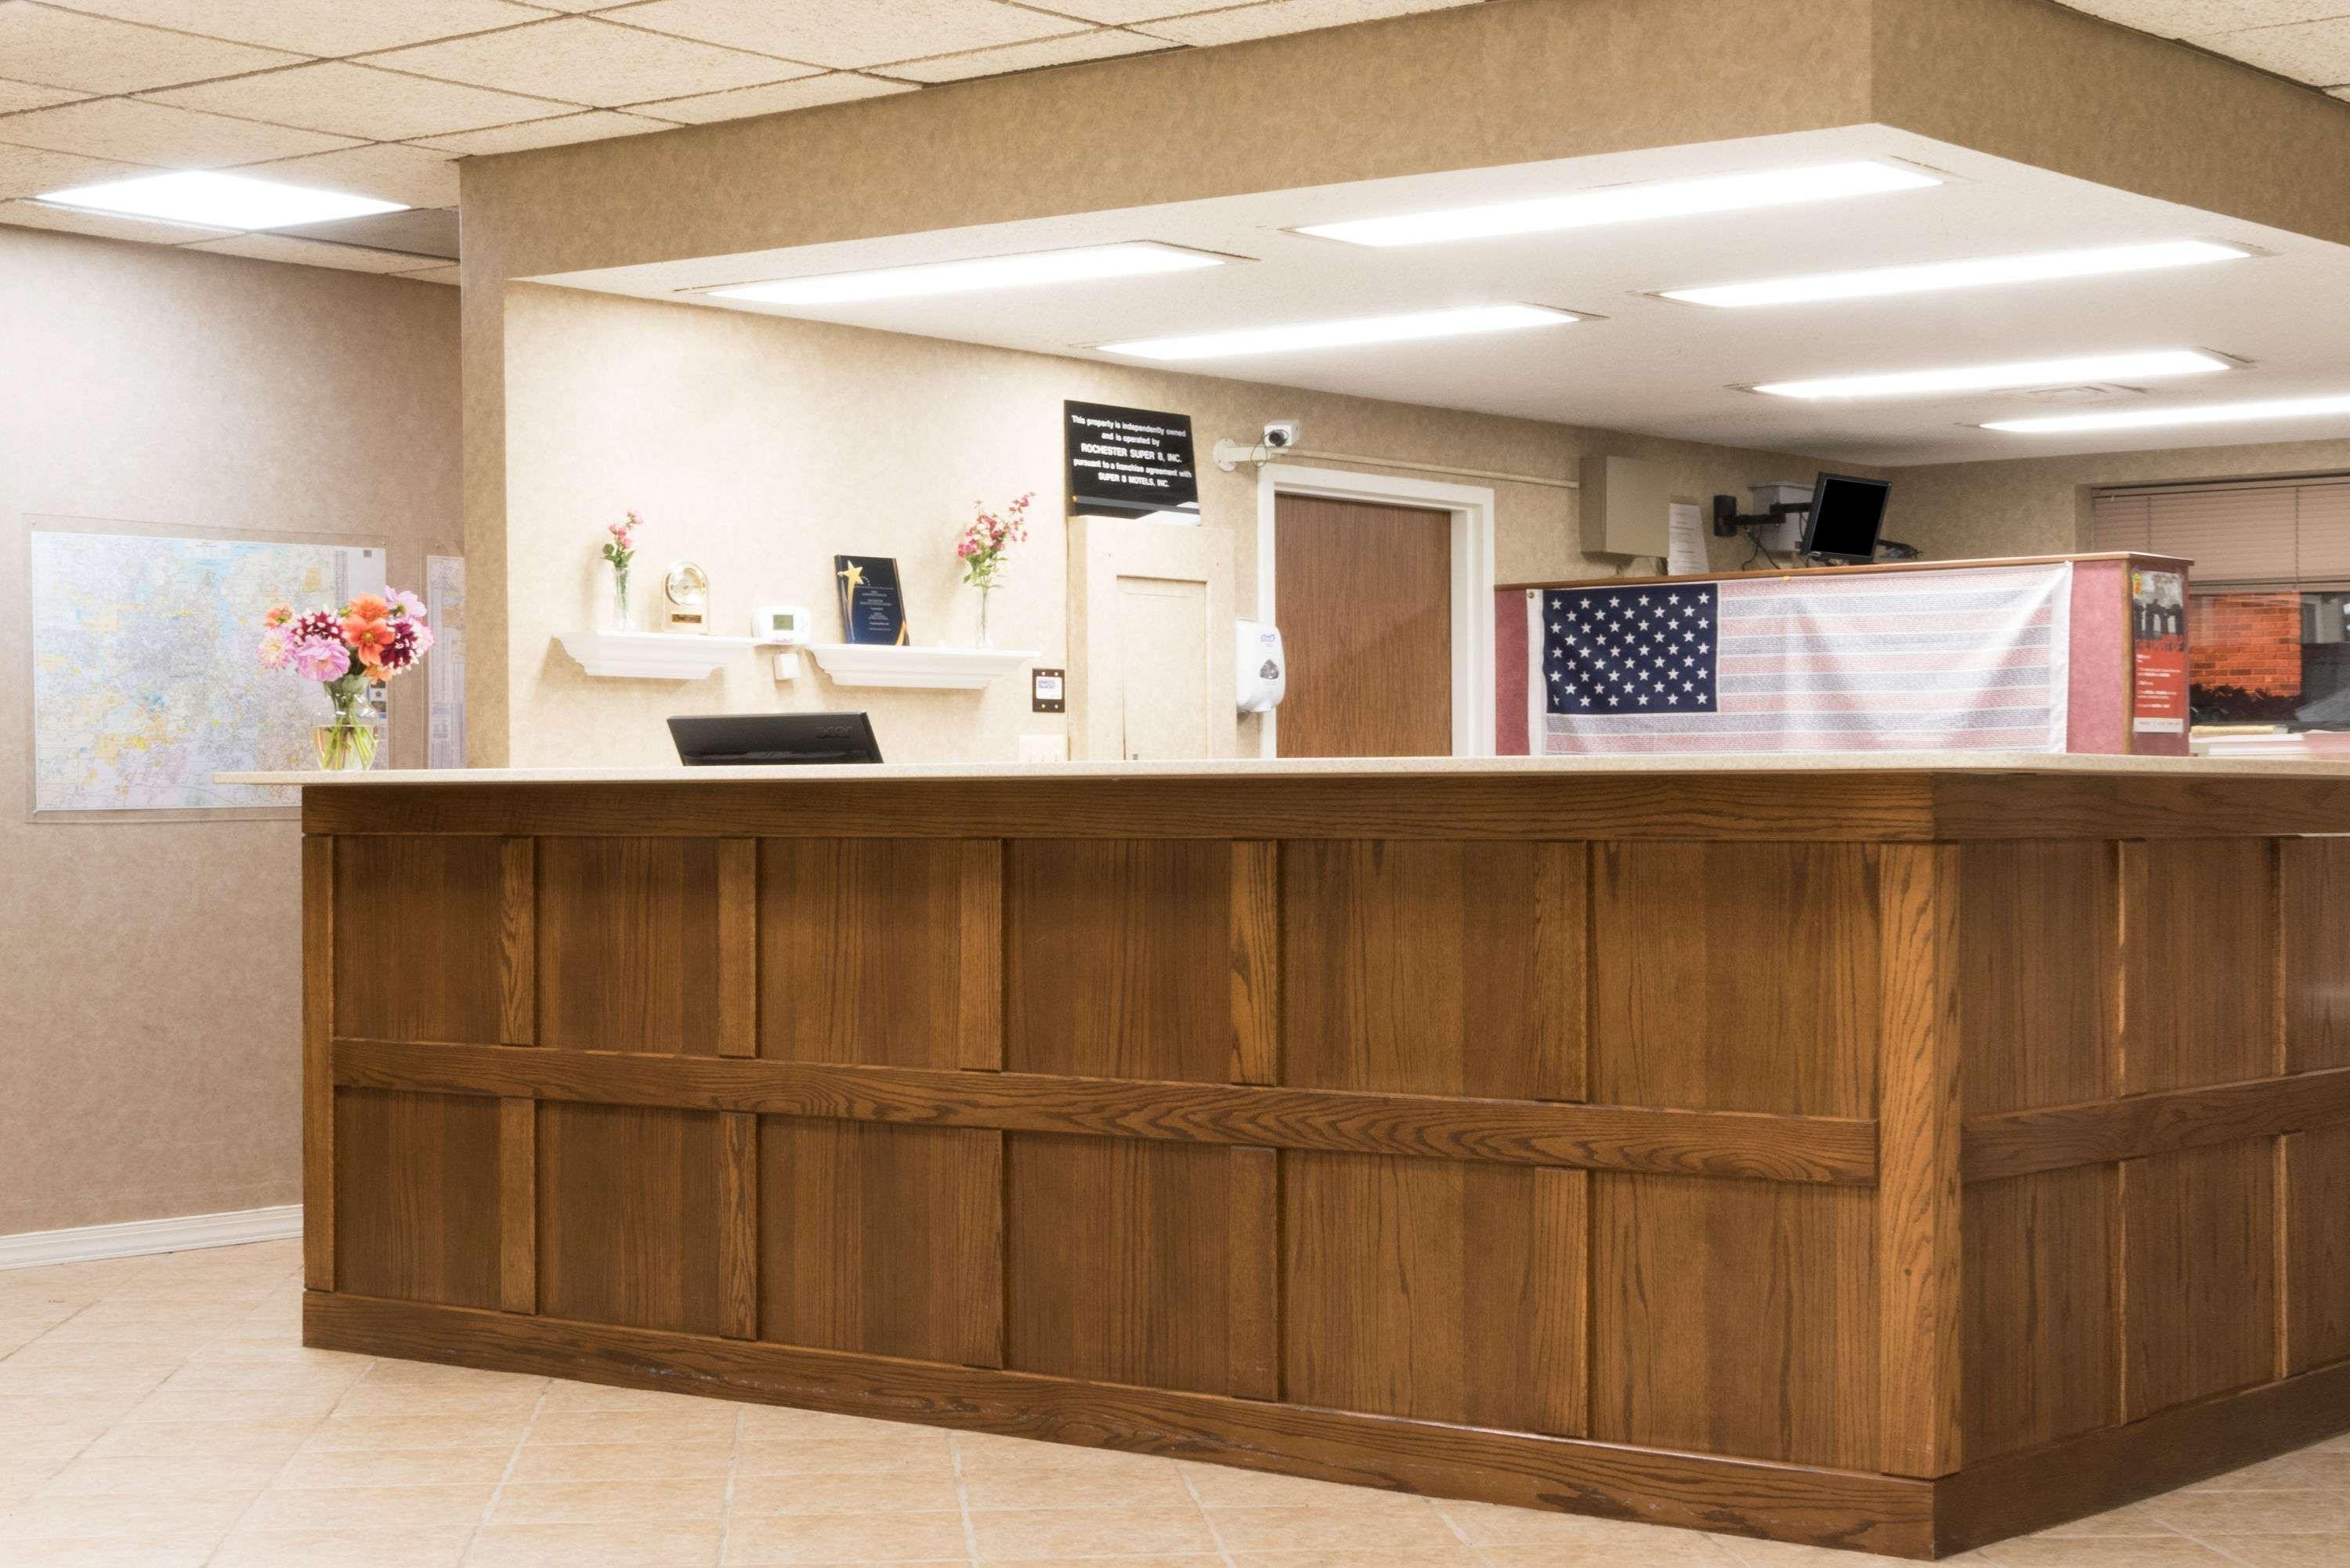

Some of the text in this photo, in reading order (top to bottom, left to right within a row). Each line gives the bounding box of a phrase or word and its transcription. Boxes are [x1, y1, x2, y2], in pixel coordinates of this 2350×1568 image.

[1086, 418, 1114, 429] property
[1123, 422, 1165, 435] independently
[1123, 435, 1151, 444] operated
[1152, 438, 1159, 446] by
[1081, 443, 1182, 463] ROCHESTER SUPER 8, INC.
[1098, 472, 1120, 482] SUPER
[1145, 467, 1177, 476] agreement
